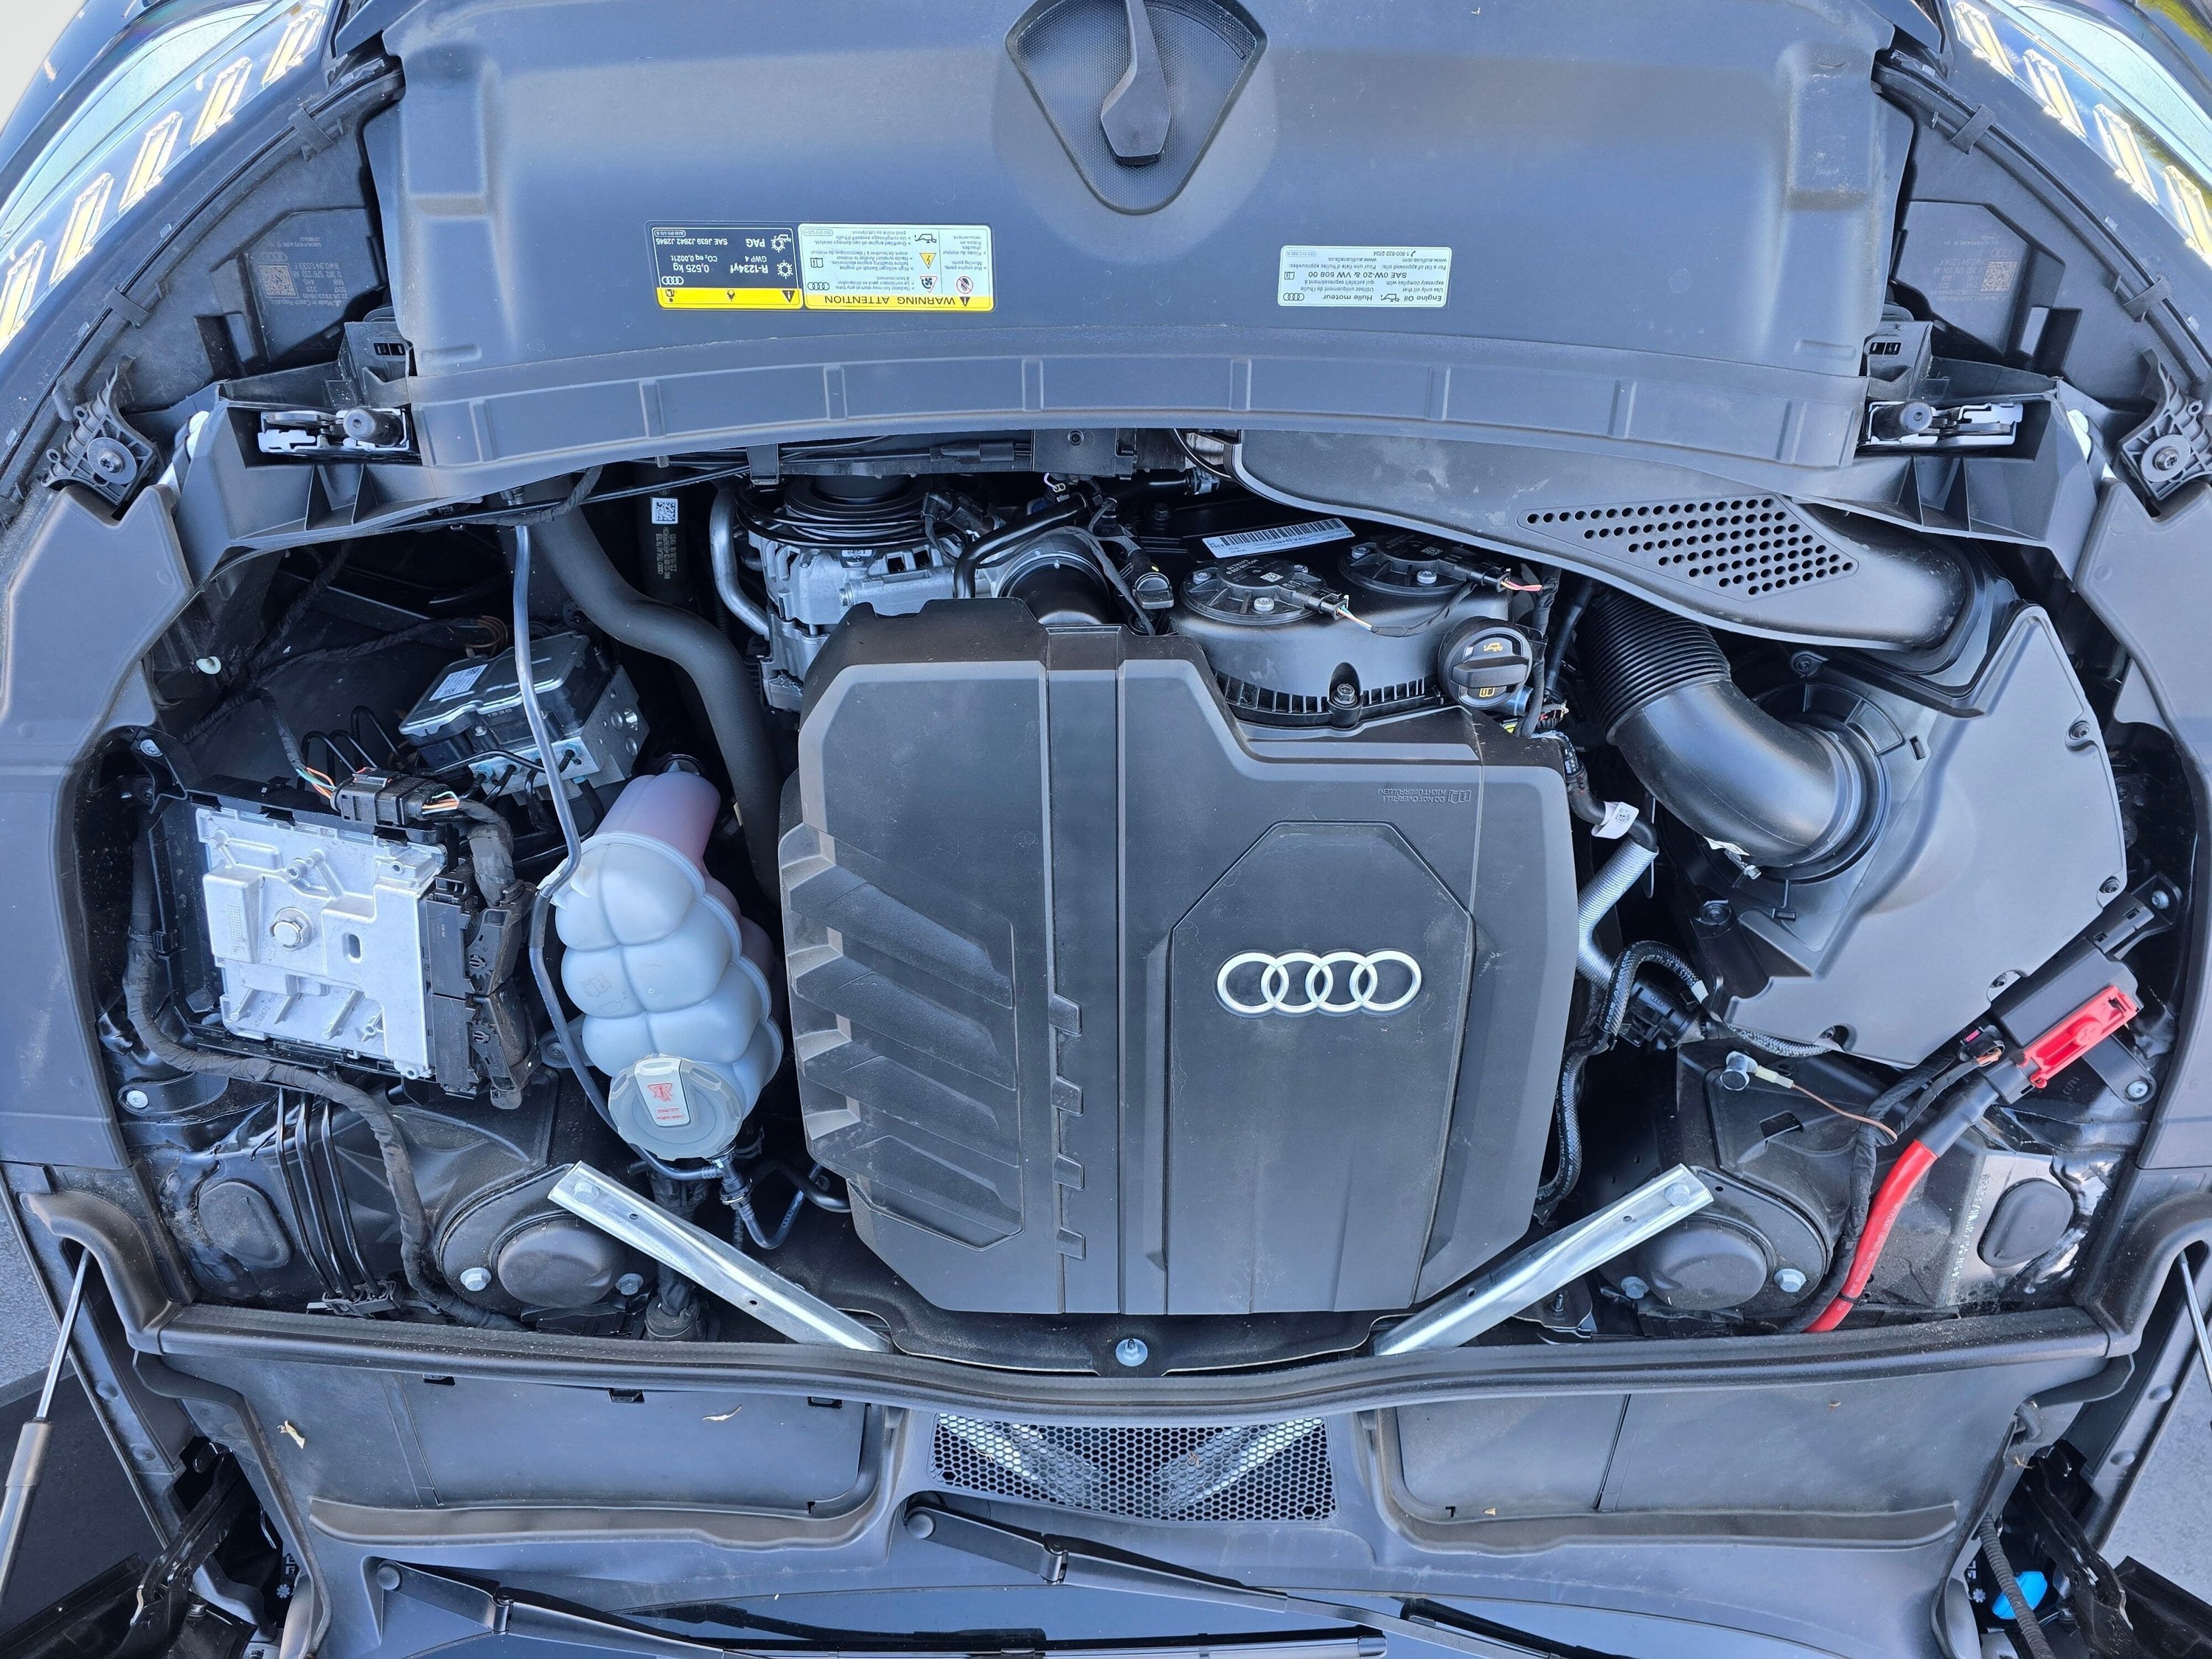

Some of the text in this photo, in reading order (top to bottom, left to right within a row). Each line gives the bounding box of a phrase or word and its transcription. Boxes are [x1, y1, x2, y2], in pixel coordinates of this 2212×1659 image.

[745, 238, 765, 248] PAG
[672, 262, 768, 274] R-1234yf 0,525 kg
[824, 296, 956, 305] WARNING ATTENTION
